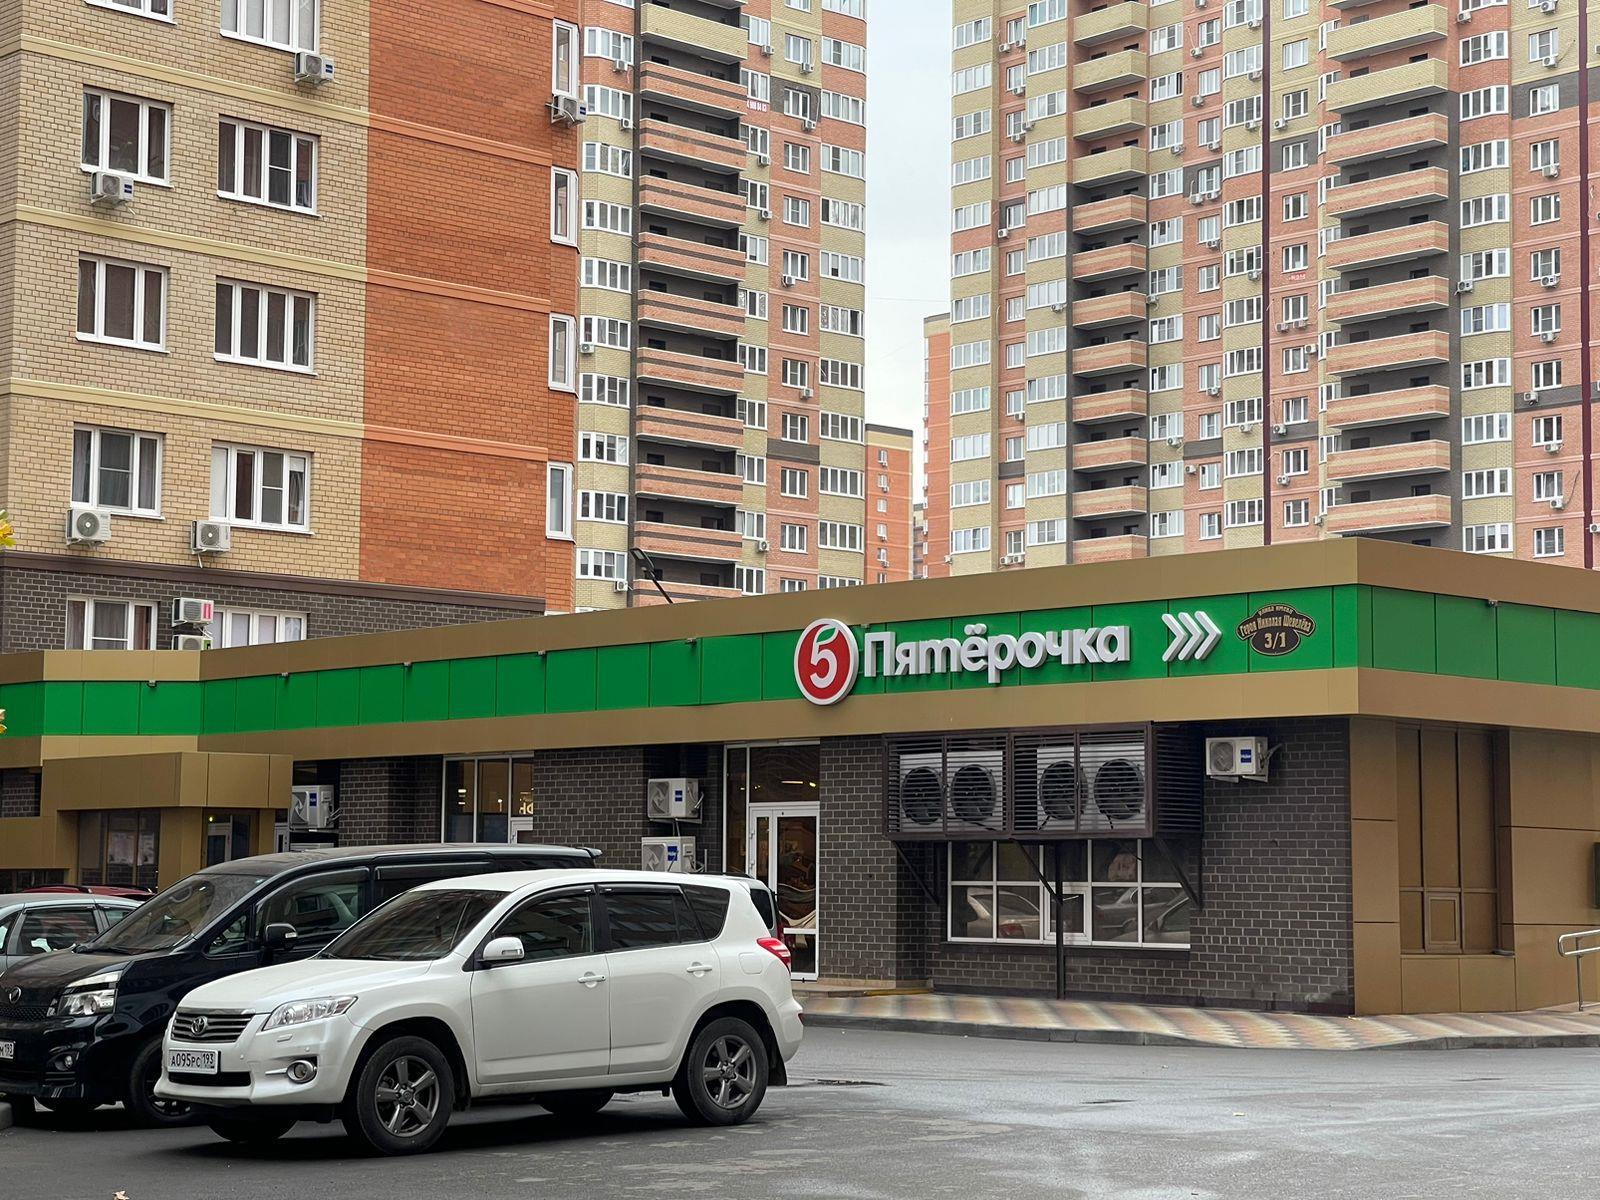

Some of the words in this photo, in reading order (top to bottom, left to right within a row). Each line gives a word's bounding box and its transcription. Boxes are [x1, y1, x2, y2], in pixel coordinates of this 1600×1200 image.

[810, 625, 839, 689] 5
[864, 623, 1130, 684] Пятёрочка
[1264, 632, 1286, 649] 3/1
